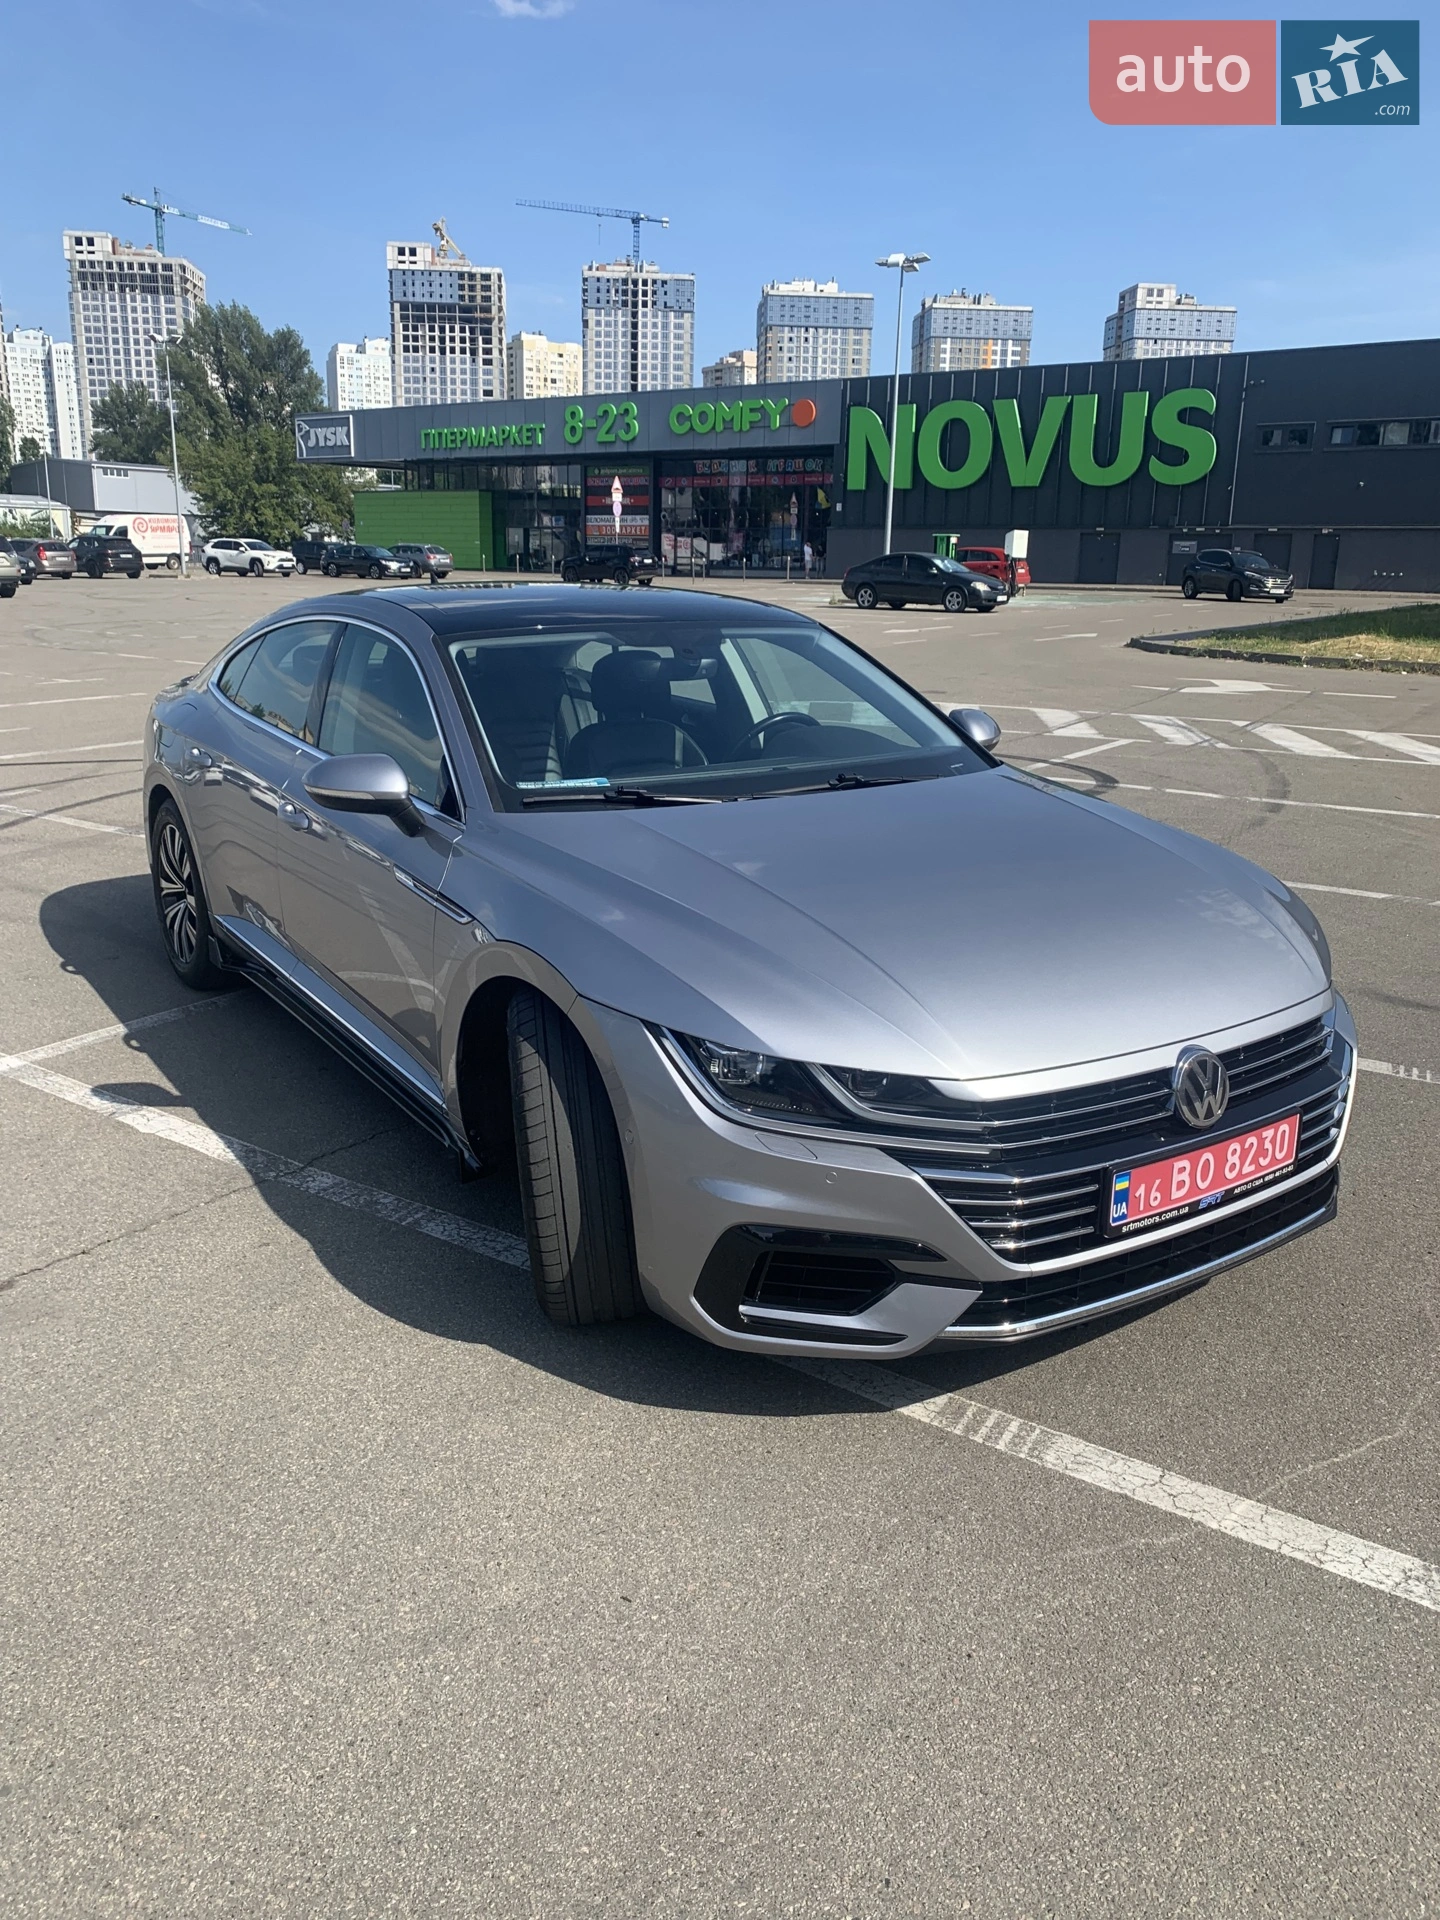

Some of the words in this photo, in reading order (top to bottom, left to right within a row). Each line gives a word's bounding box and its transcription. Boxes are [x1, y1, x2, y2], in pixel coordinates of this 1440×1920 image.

[563, 401, 639, 445] 8-23
[669, 397, 789, 435] COMFY
[307, 426, 351, 448] JYSK
[420, 423, 546, 450] ГІПЕРМАРКЕТ
[846, 387, 1218, 491] NOVUS
[586, 516, 628, 524] ВЕЛОМАГАИН
[1134, 1178, 1162, 1211] 16
[1224, 1123, 1290, 1181] 8230
[1112, 1203, 1128, 1218] UA
[1121, 1205, 1189, 1233] srtmotors.com.ua
